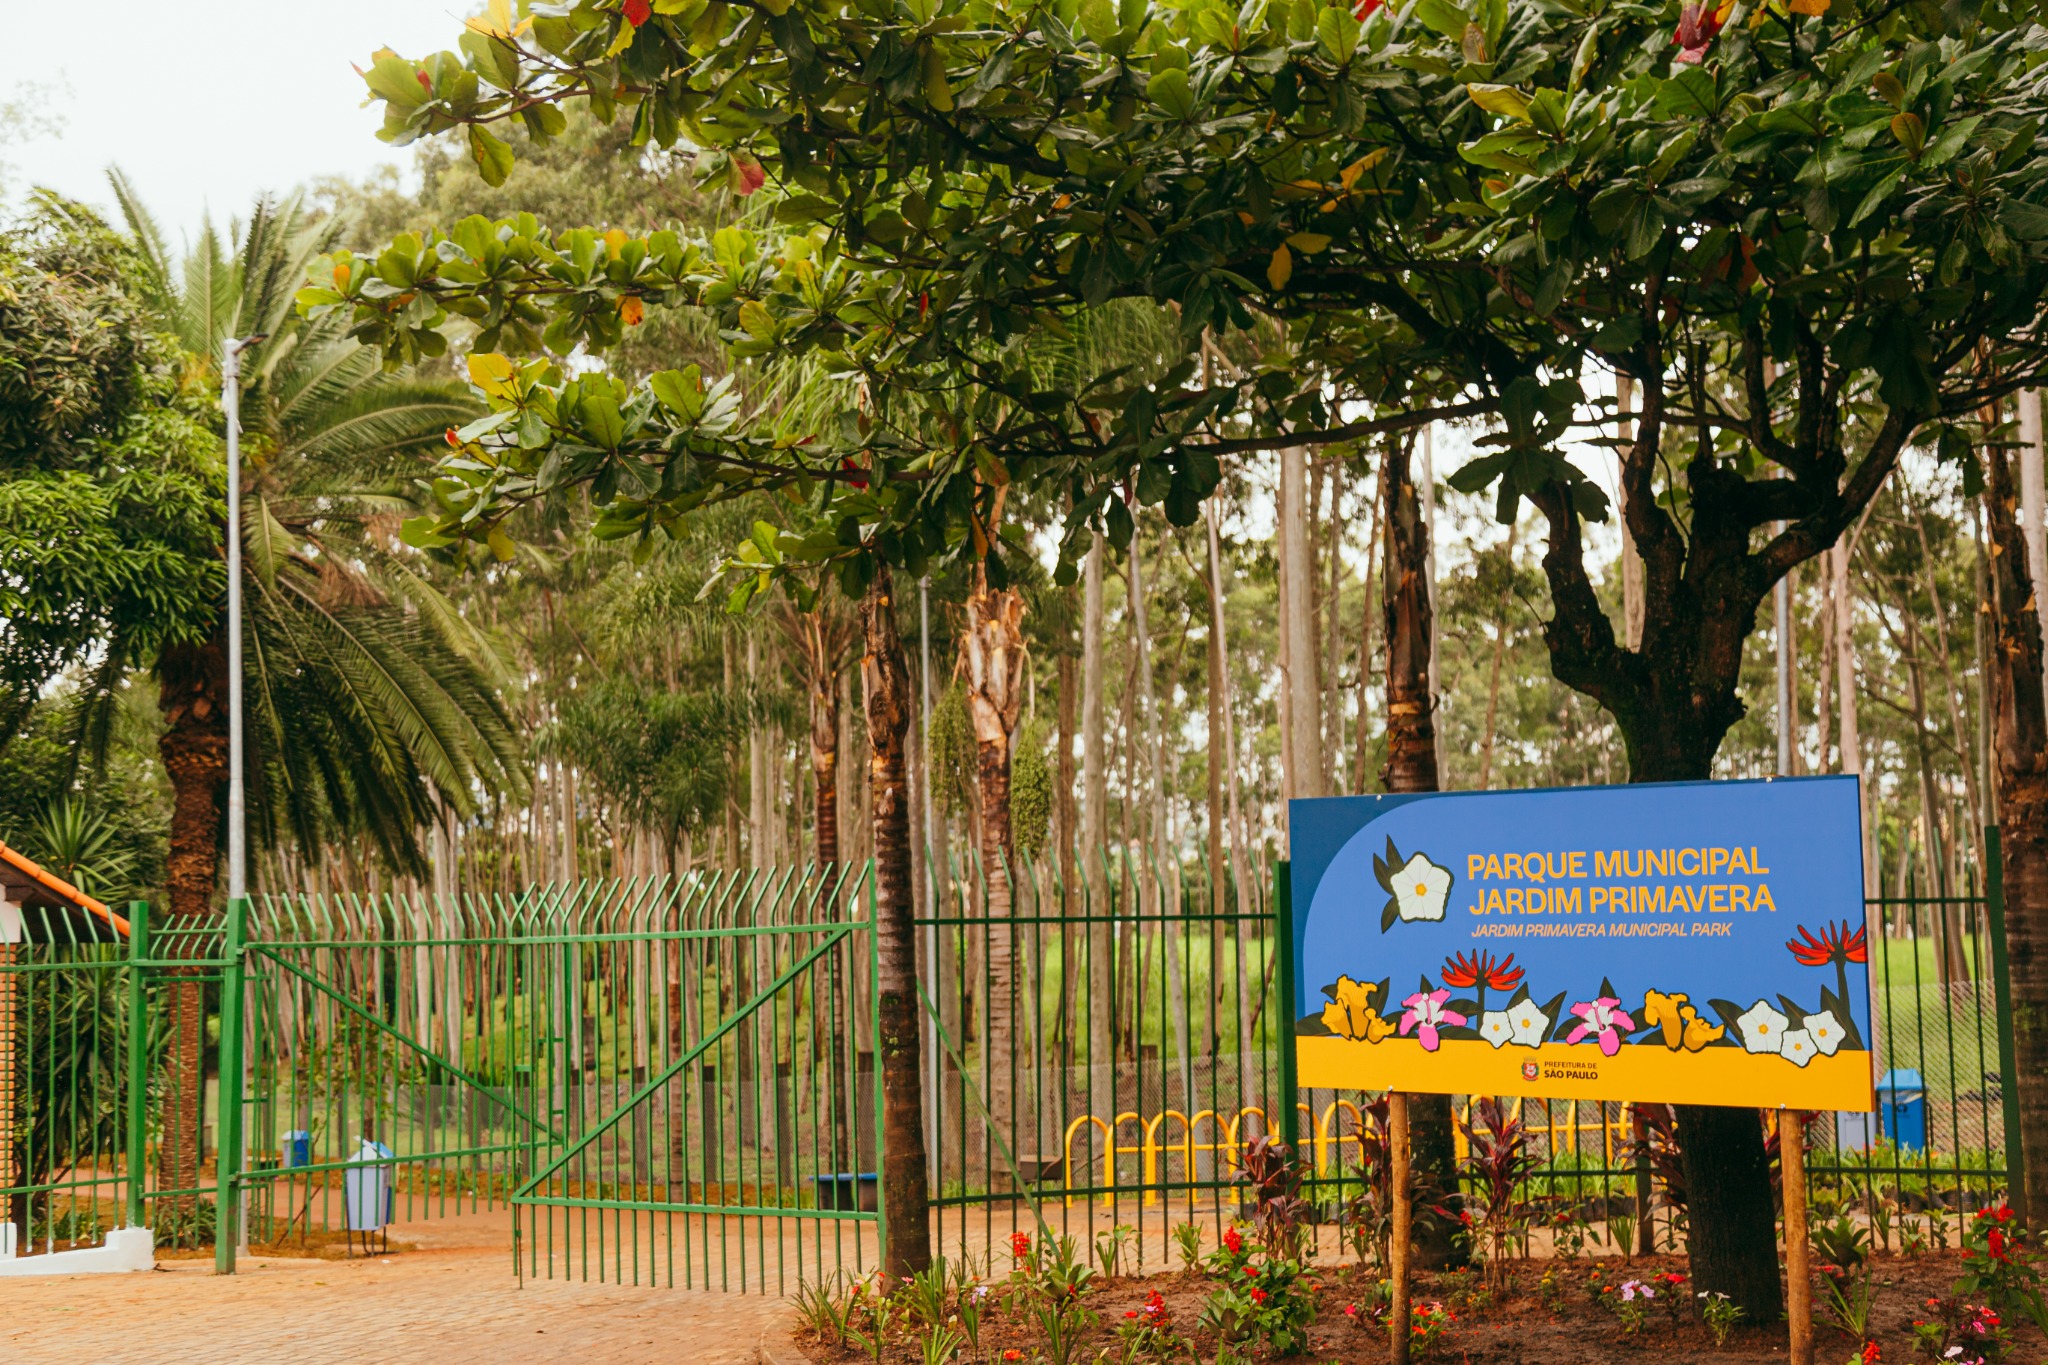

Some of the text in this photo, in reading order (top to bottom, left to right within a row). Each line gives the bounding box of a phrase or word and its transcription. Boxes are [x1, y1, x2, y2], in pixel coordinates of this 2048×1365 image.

[1467, 846, 1770, 883] PARQUE MUNICIPAL
[1469, 884, 1777, 915] JARDIM PRIMAVERA
[1471, 922, 1732, 937] JARDIM PRIMAVERA MUNICIPAL PARK
[1544, 1061, 1585, 1069] PREFEITURA
[1544, 1068, 1598, 1080] SÃO PAULO
